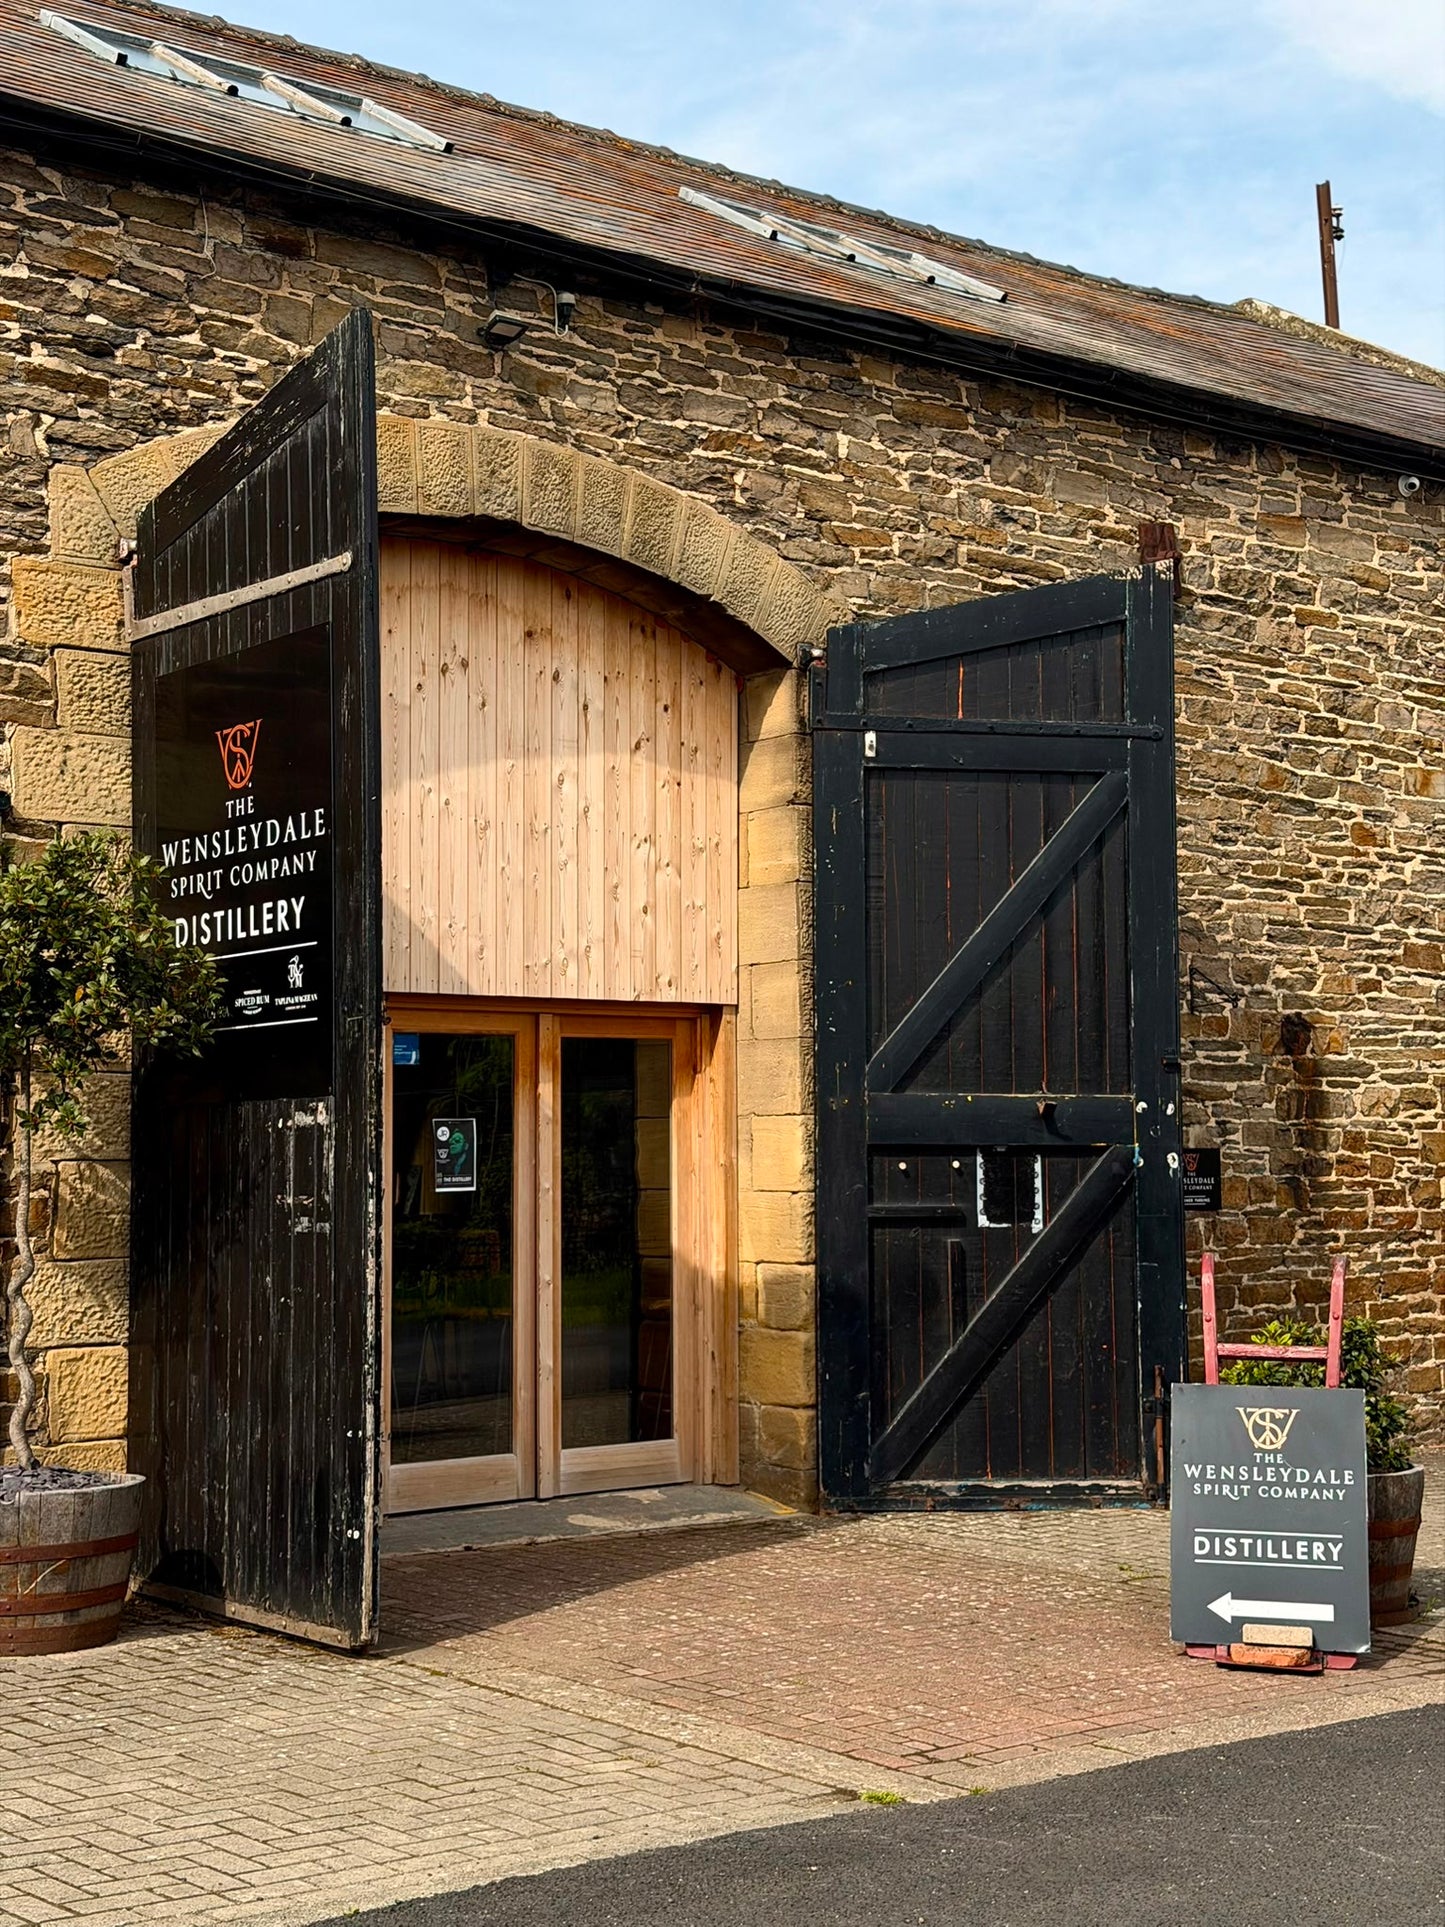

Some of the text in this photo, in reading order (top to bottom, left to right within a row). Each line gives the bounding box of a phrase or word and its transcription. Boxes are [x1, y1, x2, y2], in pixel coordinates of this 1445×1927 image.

[225, 795, 255, 819] THE
[162, 807, 326, 868] WENSLEYDALE
[170, 850, 318, 900] SPIRIT COMPANY
[175, 895, 306, 949] DISTILLERY
[234, 996, 256, 1007] SPICED
[1253, 1452, 1284, 1464] THE
[1184, 1464, 1355, 1485] WENSLEYDALE
[1193, 1483, 1346, 1501] SPIRIT COMPANY
[1193, 1535, 1344, 1562] DISTILLERY
